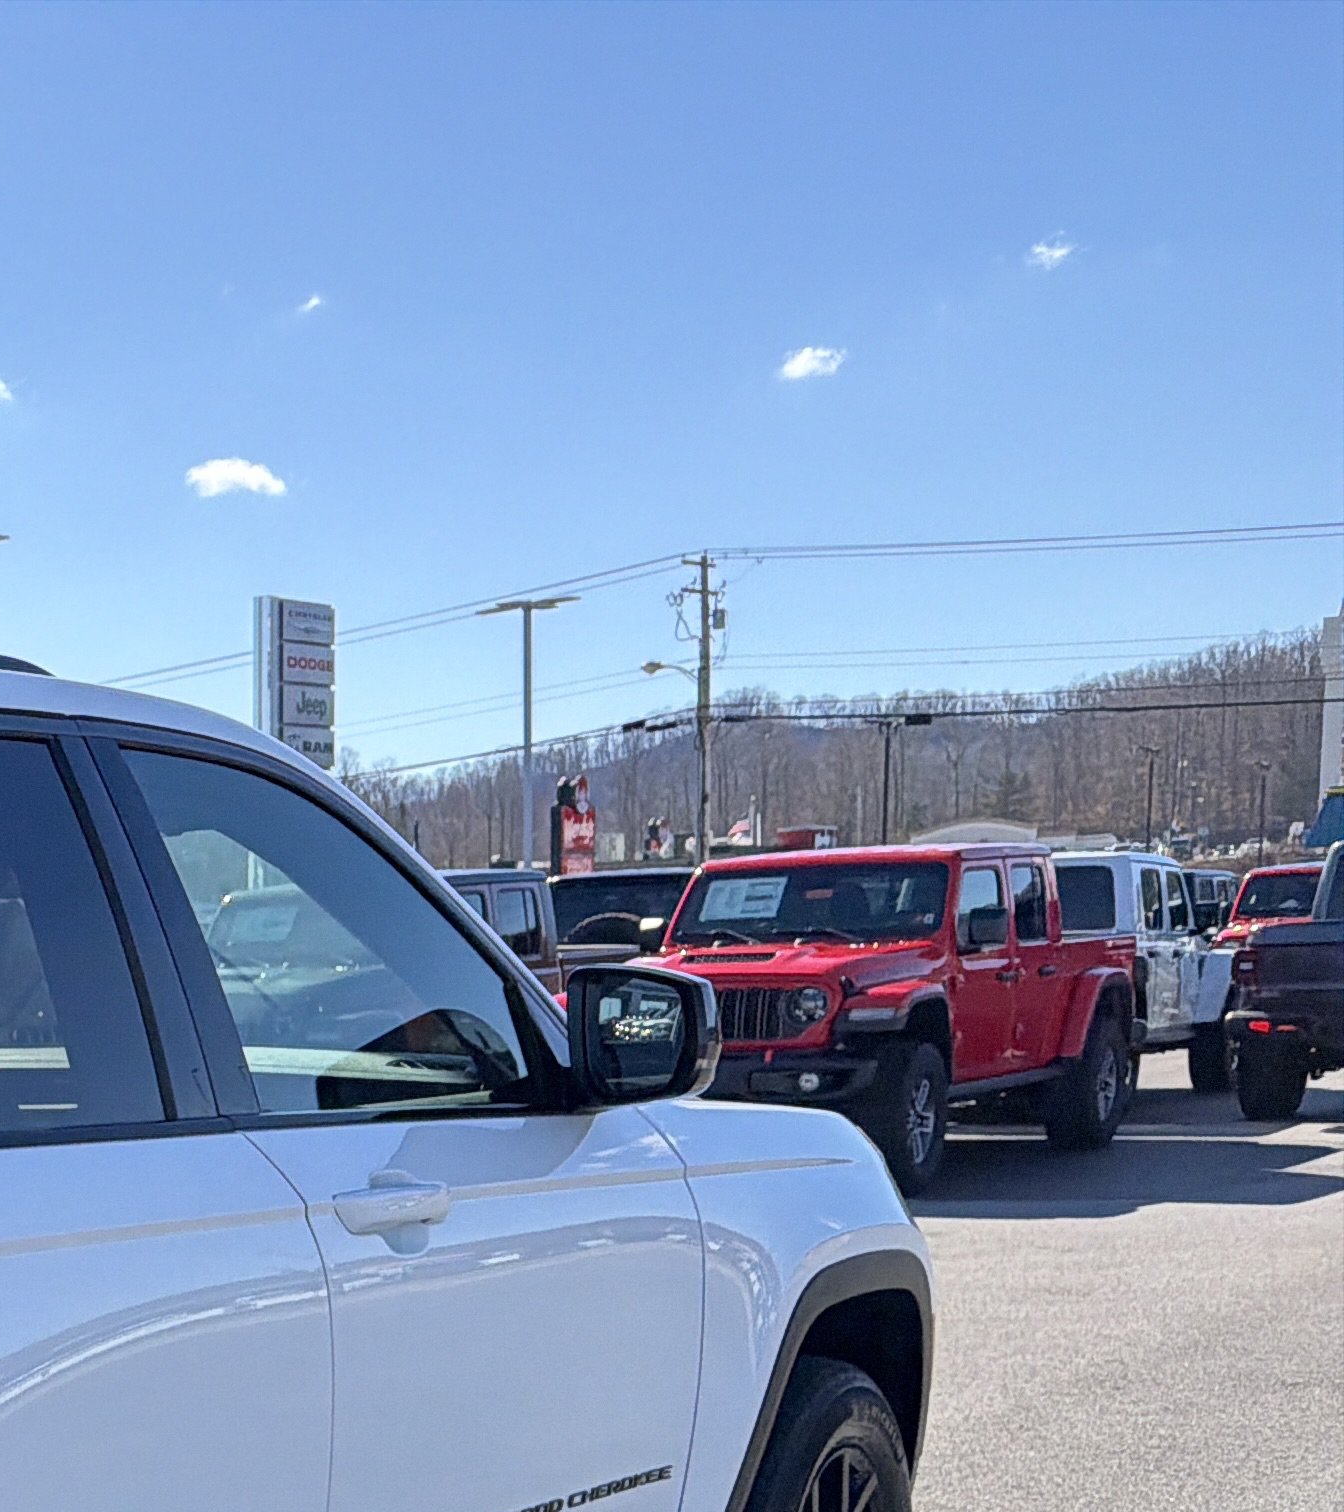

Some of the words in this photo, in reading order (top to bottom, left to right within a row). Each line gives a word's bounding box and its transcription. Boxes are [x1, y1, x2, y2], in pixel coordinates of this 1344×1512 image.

[287, 656, 332, 672] DODGE
[296, 690, 327, 720] Jeep
[567, 1465, 672, 1508] CHEROKEE
